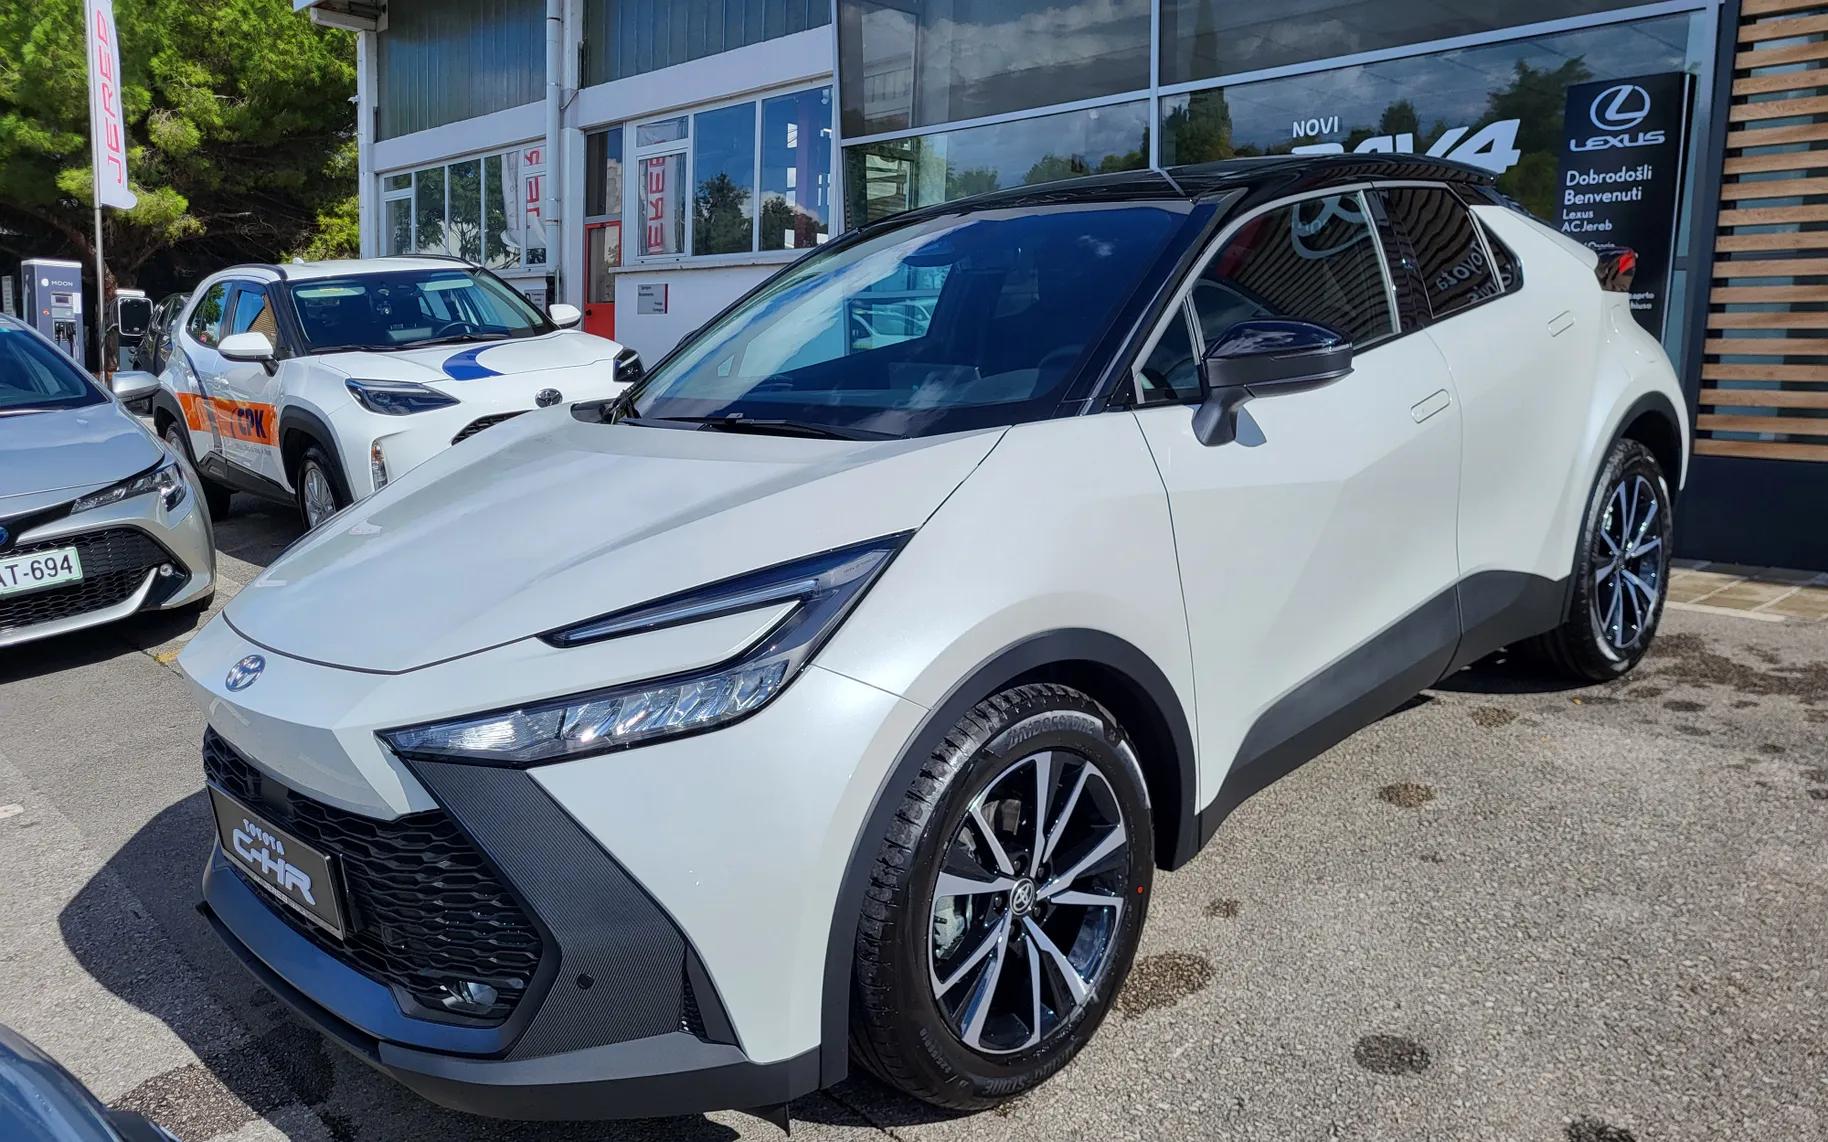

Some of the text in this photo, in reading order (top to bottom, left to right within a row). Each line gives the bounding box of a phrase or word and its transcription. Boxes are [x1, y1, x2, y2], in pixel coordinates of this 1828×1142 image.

[1292, 116, 1339, 138] NOVI
[1569, 130, 1666, 152] LEXUS
[1566, 164, 1653, 187] Dobrodošli
[1563, 186, 1643, 206] Benvenuti
[1562, 208, 1594, 220] Lexus
[242, 818, 285, 856] TOYOTA
[232, 828, 316, 906] C-HR
